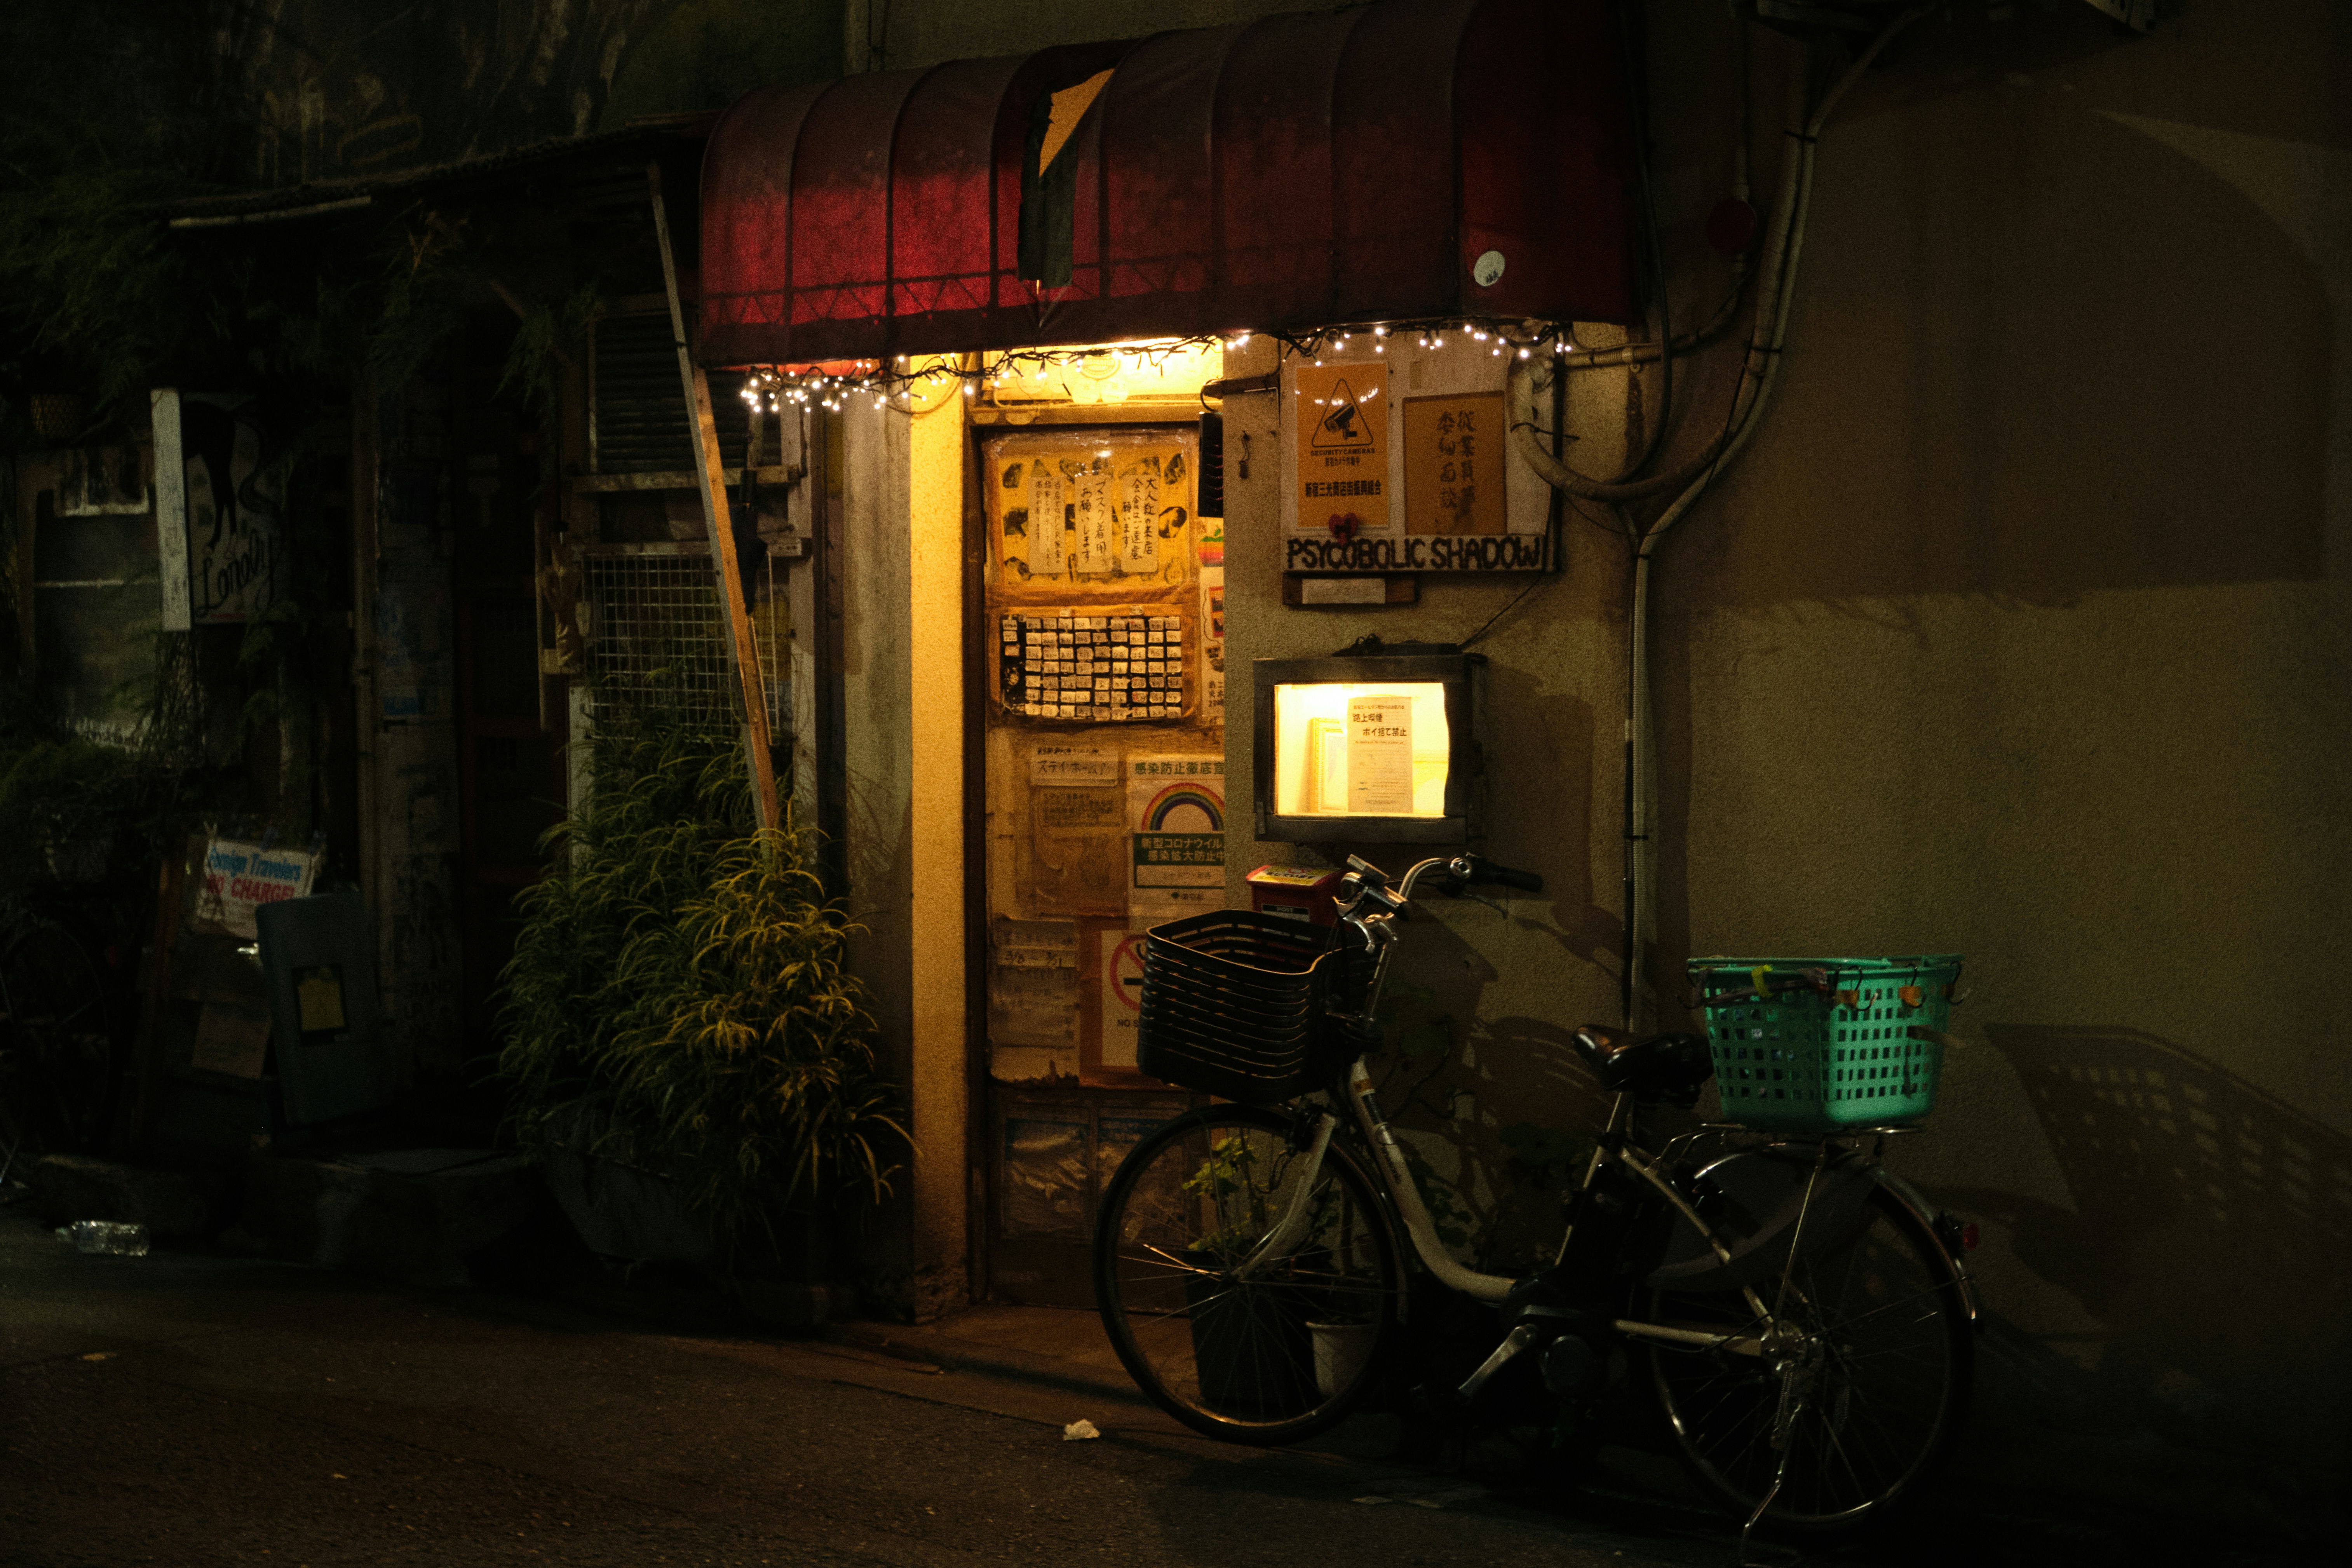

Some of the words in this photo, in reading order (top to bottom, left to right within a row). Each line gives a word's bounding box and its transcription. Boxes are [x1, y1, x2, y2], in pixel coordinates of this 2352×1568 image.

[1079, 487, 1092, 563] お願いします
[1095, 481, 1106, 554] マスク着用
[1287, 538, 1426, 570] PSYCOBOLIC
[1430, 537, 1540, 569] SHADOW
[1352, 713, 1383, 723] 路上喫煙
[1141, 837, 1225, 849] 新型コロナウイル
[250, 853, 302, 882] Travelers
[1117, 1019, 1131, 1028] NO
